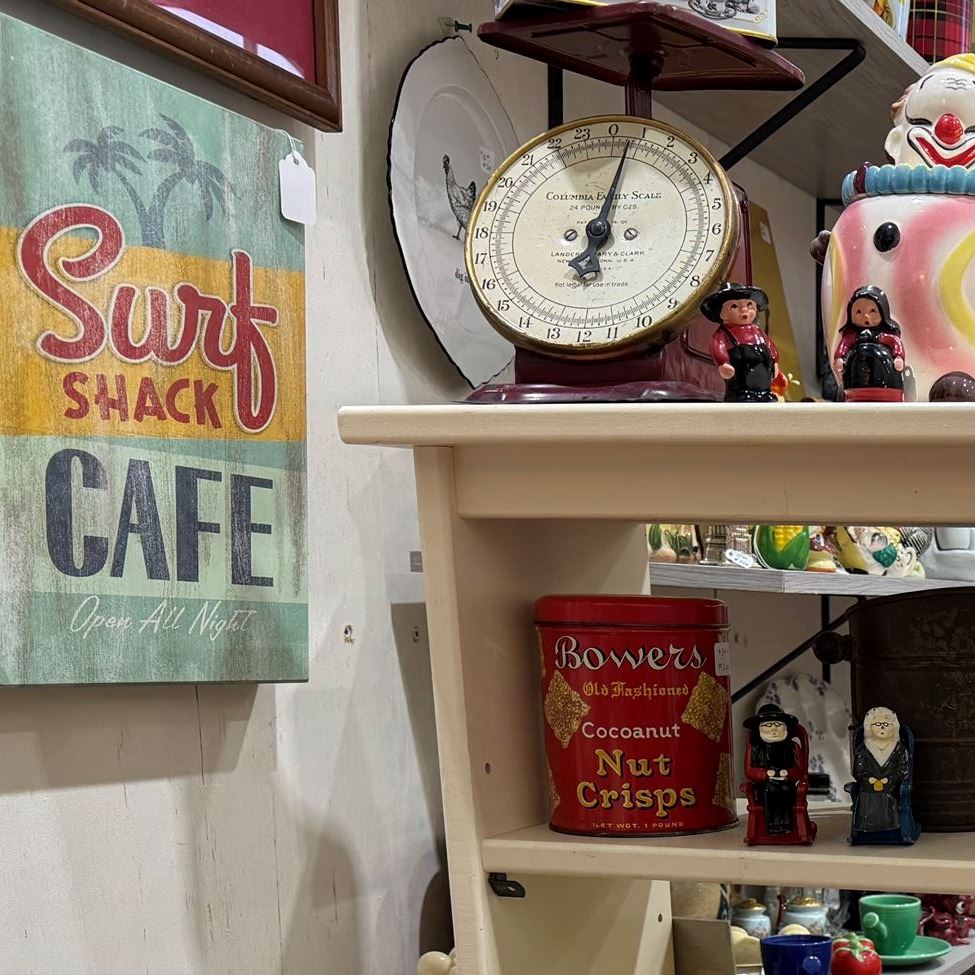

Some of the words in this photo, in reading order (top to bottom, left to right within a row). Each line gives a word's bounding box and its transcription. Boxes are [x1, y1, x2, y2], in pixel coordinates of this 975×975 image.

[574, 128, 591, 139] 23
[609, 124, 619, 136] 0
[641, 127, 647, 138] 1
[548, 138, 562, 149] 22
[667, 137, 676, 147] 2
[522, 153, 535, 167] 21
[688, 152, 698, 164] 3
[498, 177, 513, 188] 20
[703, 170, 713, 185] 4
[484, 201, 497, 212] 19
[712, 198, 721, 210] 5
[475, 227, 489, 239] 18
[711, 223, 721, 235] 6
[475, 253, 488, 264] 17
[705, 251, 714, 262] 7
[482, 279, 496, 291] 16
[690, 276, 700, 287] 8
[497, 299, 510, 312] 15
[667, 299, 677, 309] 9
[17, 202, 279, 433] Surf
[519, 316, 532, 329] 14
[636, 315, 653, 328] 10
[546, 328, 561, 340] 13
[576, 330, 591, 343] 12
[607, 328, 618, 339] 11
[62, 371, 222, 430] SHACK
[45, 448, 274, 587] CAFE
[70, 596, 133, 639] Open
[139, 600, 185, 634] All
[188, 600, 257, 641] Night
[555, 635, 707, 670] Bowers
[583, 681, 608, 697] Old
[611, 681, 689, 700] Fashioned
[582, 722, 681, 739] Cocoanut
[595, 749, 672, 777] Nut
[577, 781, 696, 817] Crisps
